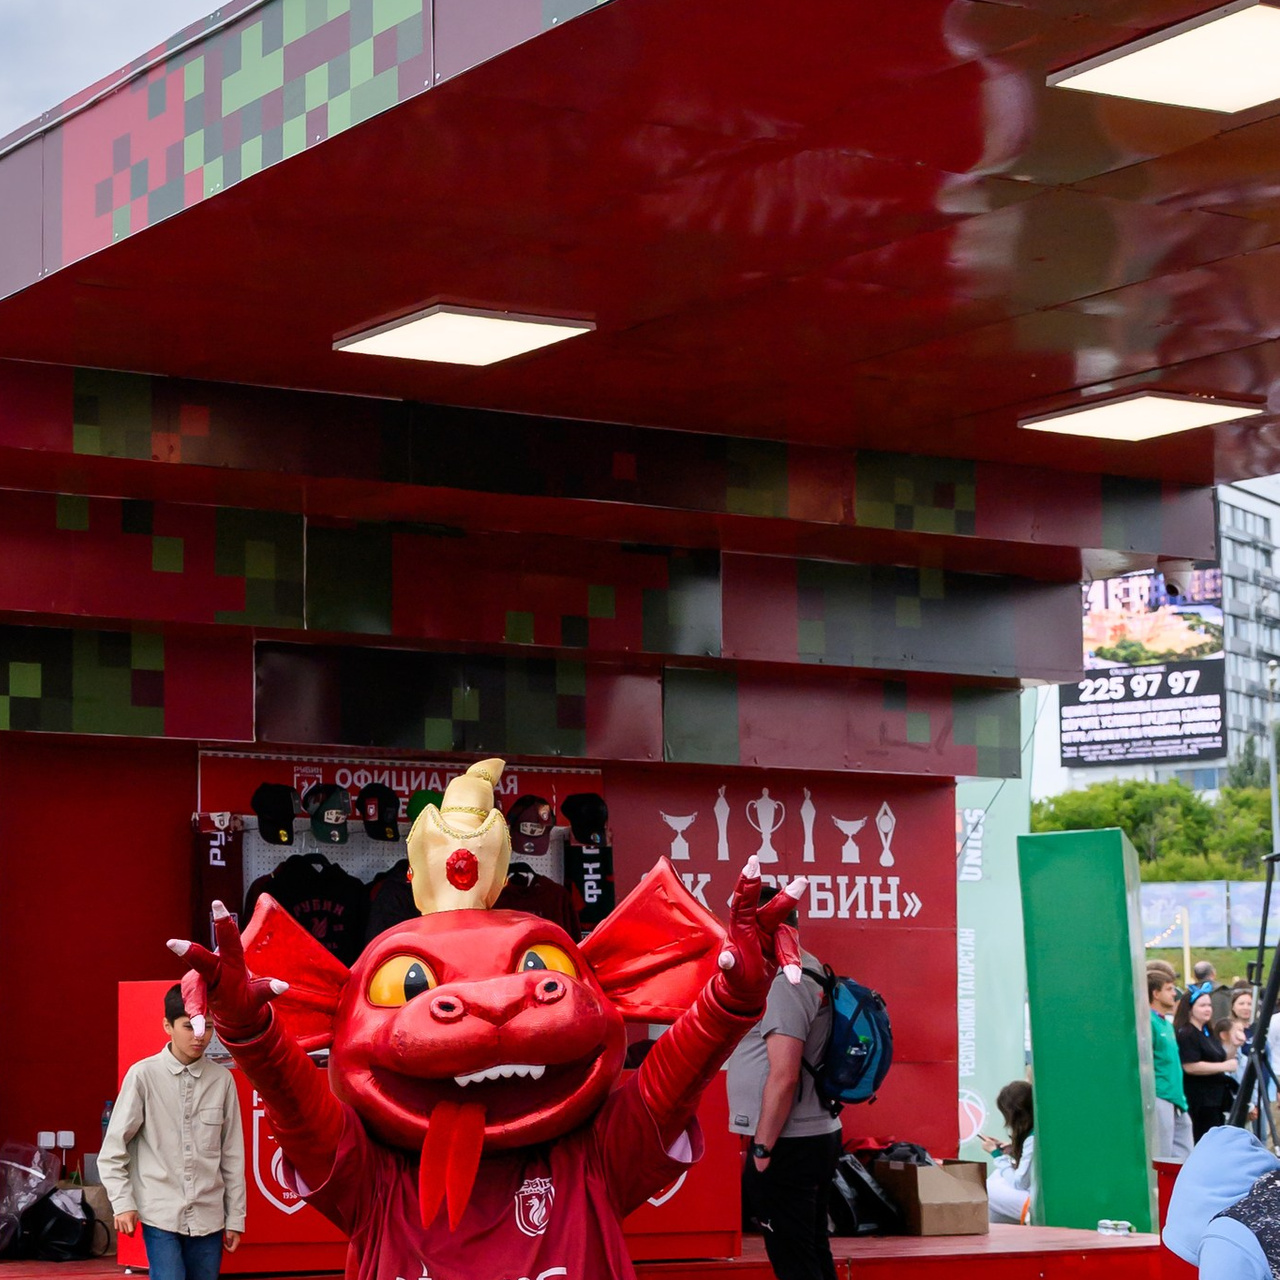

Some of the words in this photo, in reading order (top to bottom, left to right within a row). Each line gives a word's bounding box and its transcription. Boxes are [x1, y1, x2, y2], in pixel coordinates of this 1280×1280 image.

[1078, 677, 1126, 702] 225
[1129, 673, 1163, 698] 97
[1167, 669, 1201, 695] 97
[958, 808, 986, 881] UNICS
[958, 928, 976, 996] ТАТАРСТАН
[958, 999, 976, 1077] РЕСПУБЛИКИ
